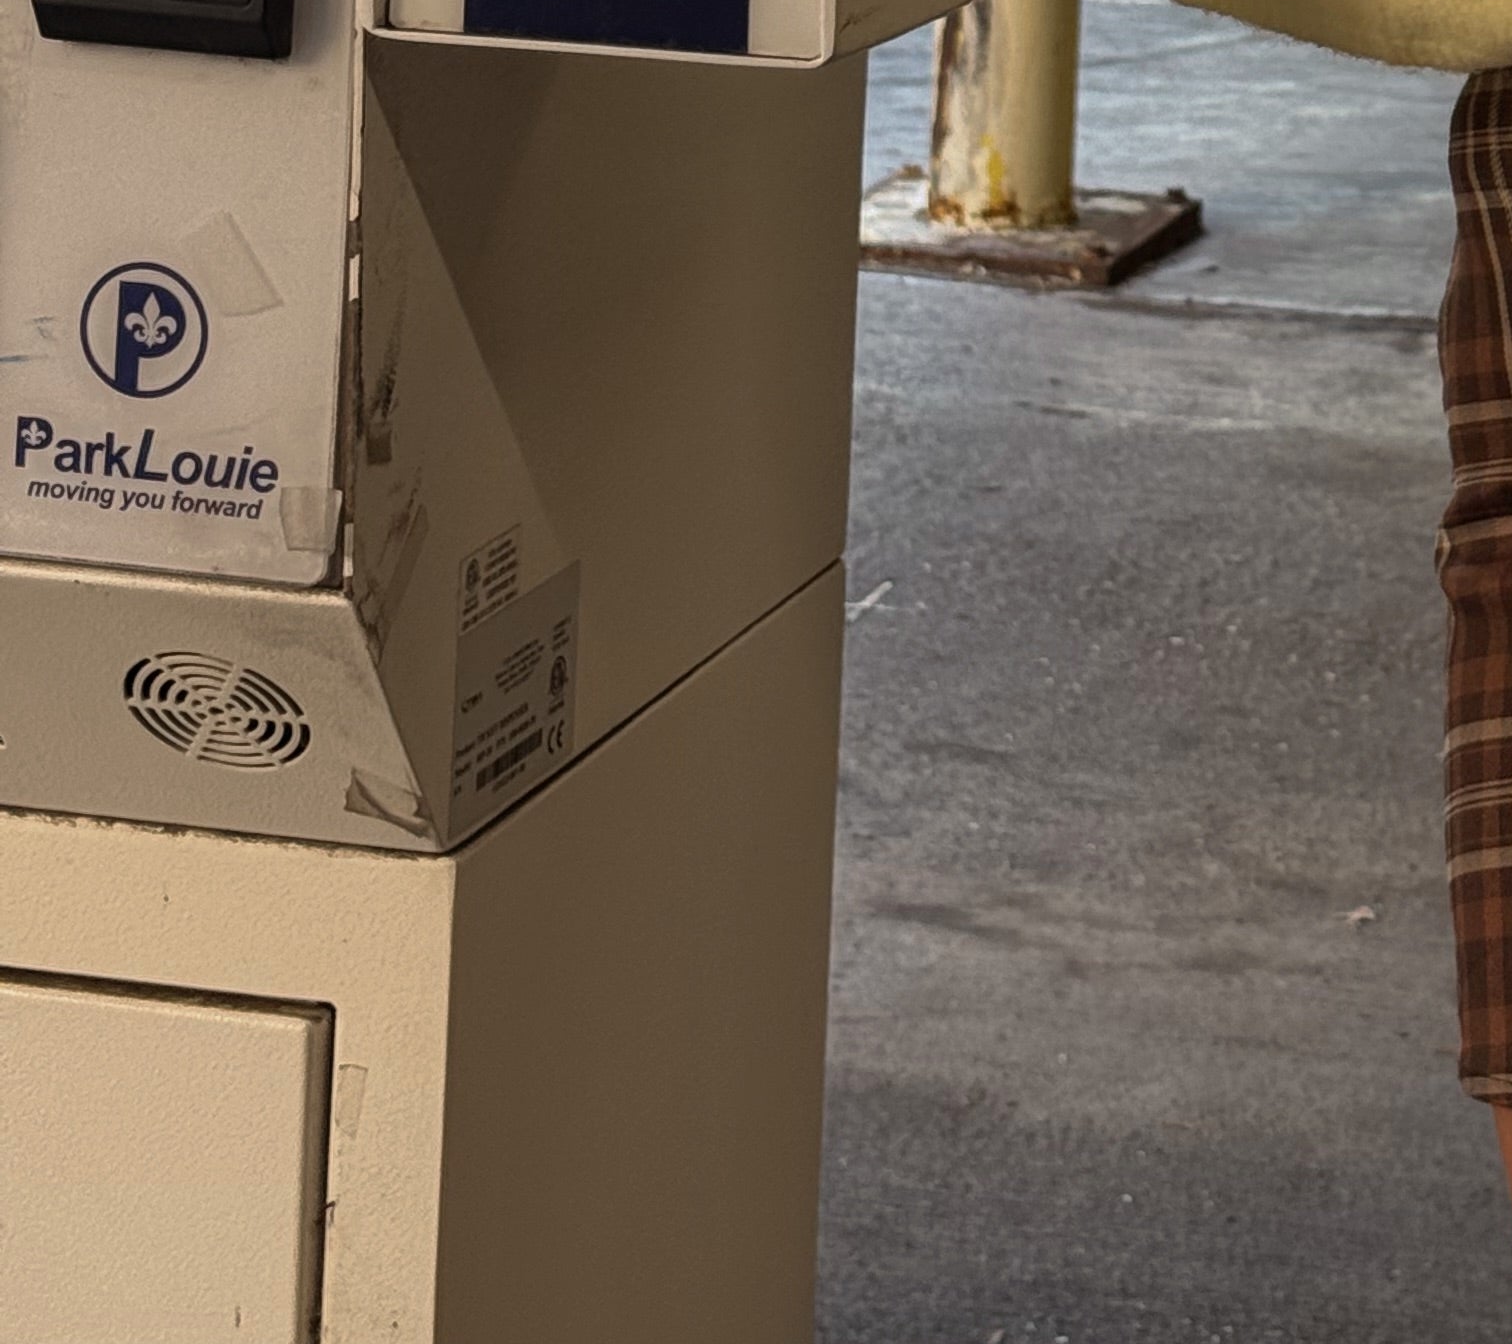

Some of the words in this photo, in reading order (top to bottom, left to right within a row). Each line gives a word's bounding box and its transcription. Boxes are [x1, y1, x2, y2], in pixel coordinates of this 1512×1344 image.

[15, 415, 279, 493] ParkLouie
[27, 480, 115, 510] moving
[120, 490, 165, 511] you
[171, 490, 263, 520] forward
